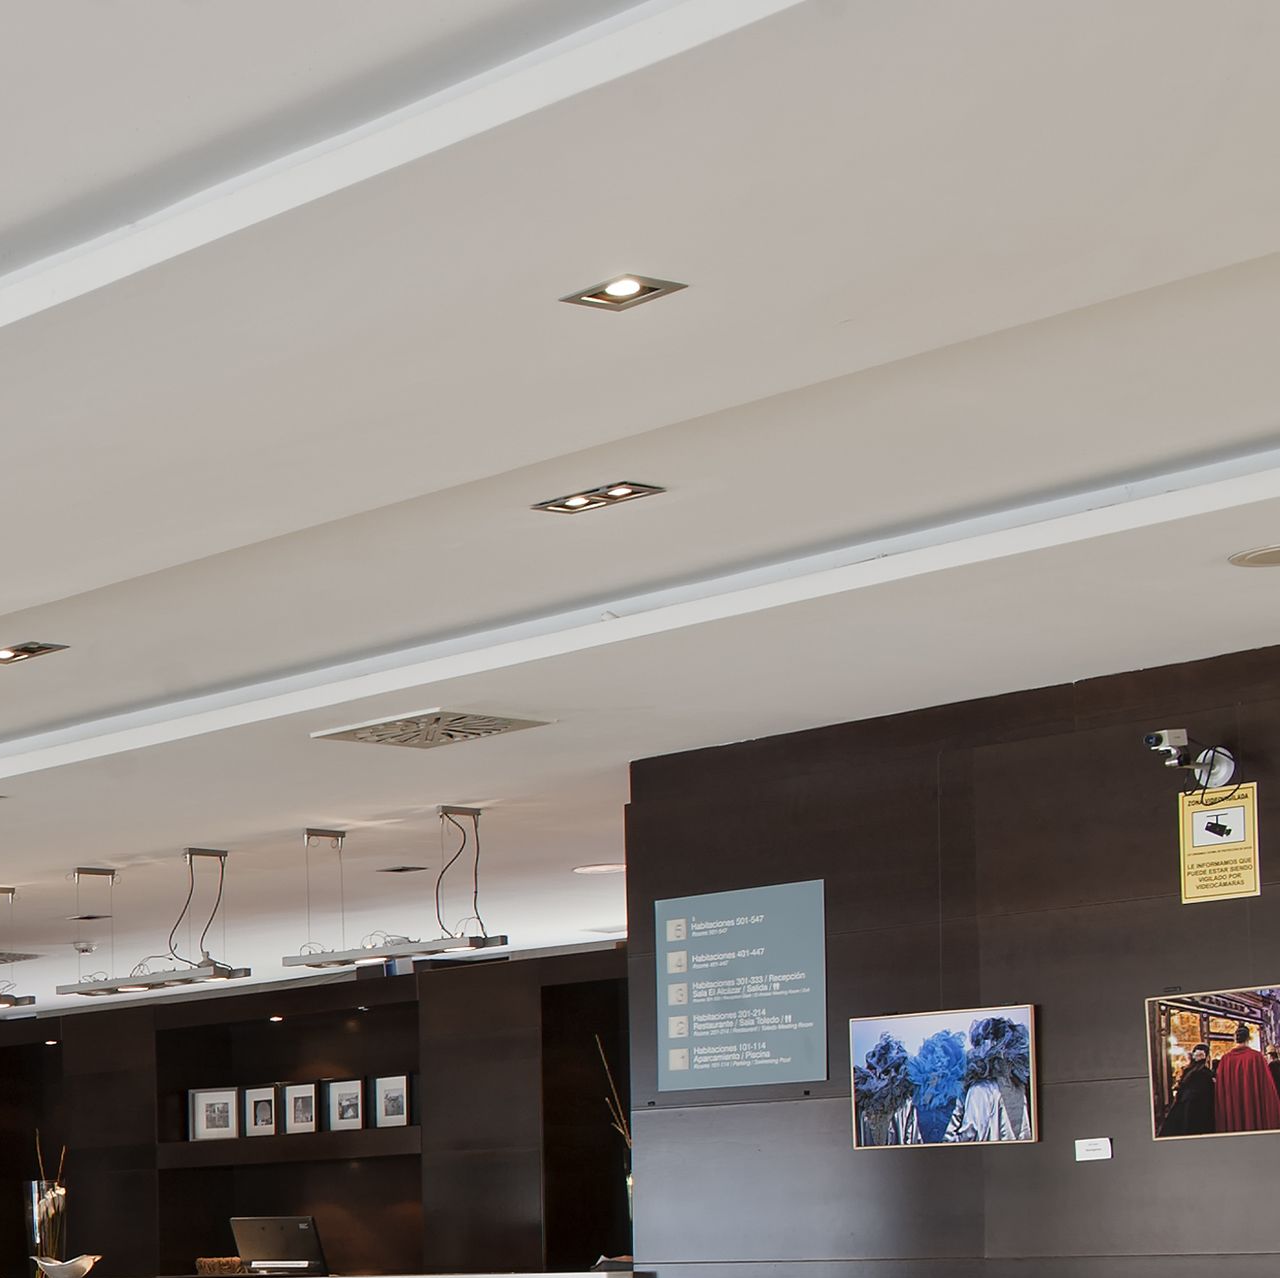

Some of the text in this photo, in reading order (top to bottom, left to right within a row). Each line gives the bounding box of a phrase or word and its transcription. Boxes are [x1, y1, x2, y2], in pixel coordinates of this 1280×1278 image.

[1209, 866, 1229, 875] ESTAR
[1228, 872, 1242, 880] POR
[691, 919, 735, 931] Habitaciones
[692, 952, 736, 963] Habitaciones
[692, 979, 735, 990] Habitaciones
[692, 989, 708, 998] Sala
[693, 1012, 737, 1022] Habitaciones
[693, 1020, 734, 1030] Restaurante
[739, 1018, 755, 1027] Sala
[756, 1016, 780, 1025] Toledo
[693, 1041, 767, 1055] Habitaciones 101-114
[745, 1050, 771, 1059] Piscina
